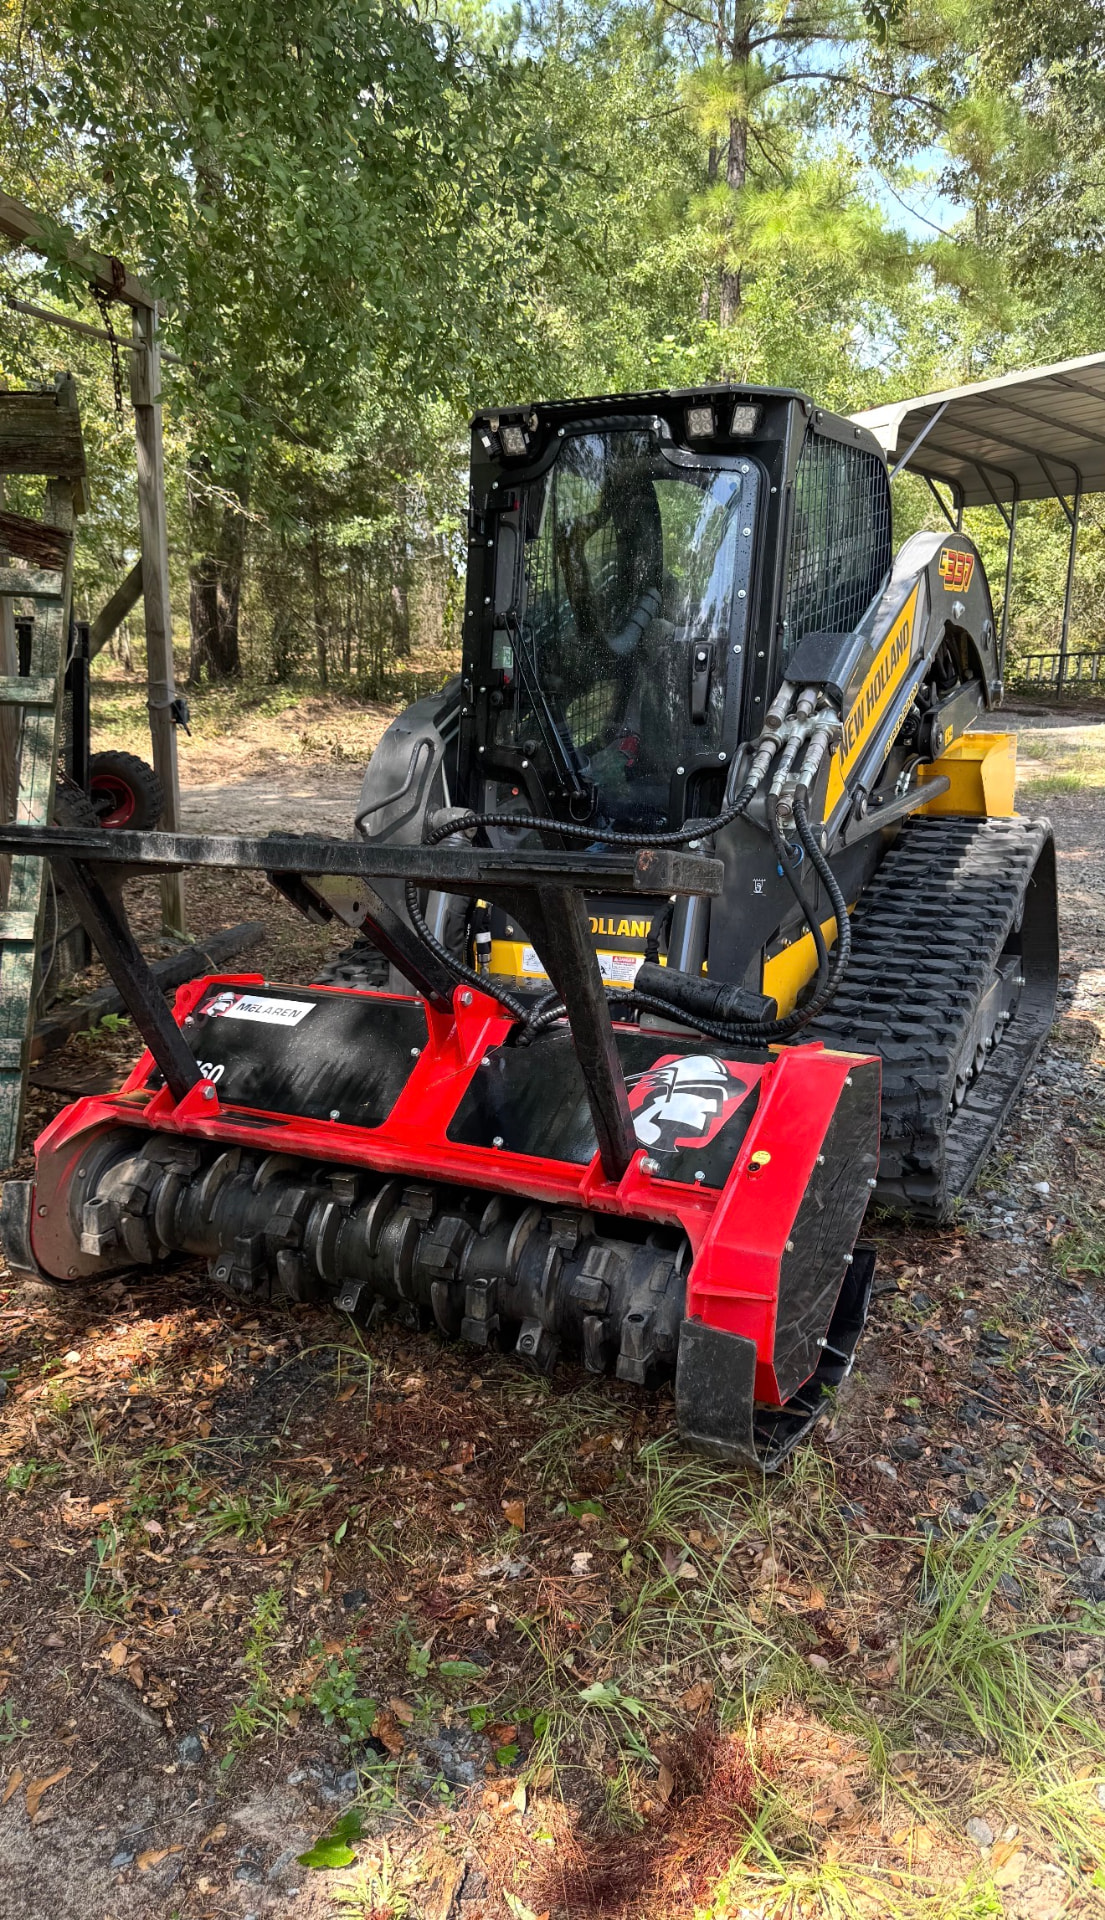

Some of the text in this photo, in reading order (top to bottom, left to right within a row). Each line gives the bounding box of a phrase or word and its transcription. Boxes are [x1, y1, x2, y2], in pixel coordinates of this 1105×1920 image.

[839, 619, 910, 766] NEW HOLLAND
[588, 917, 652, 937] OLLAN
